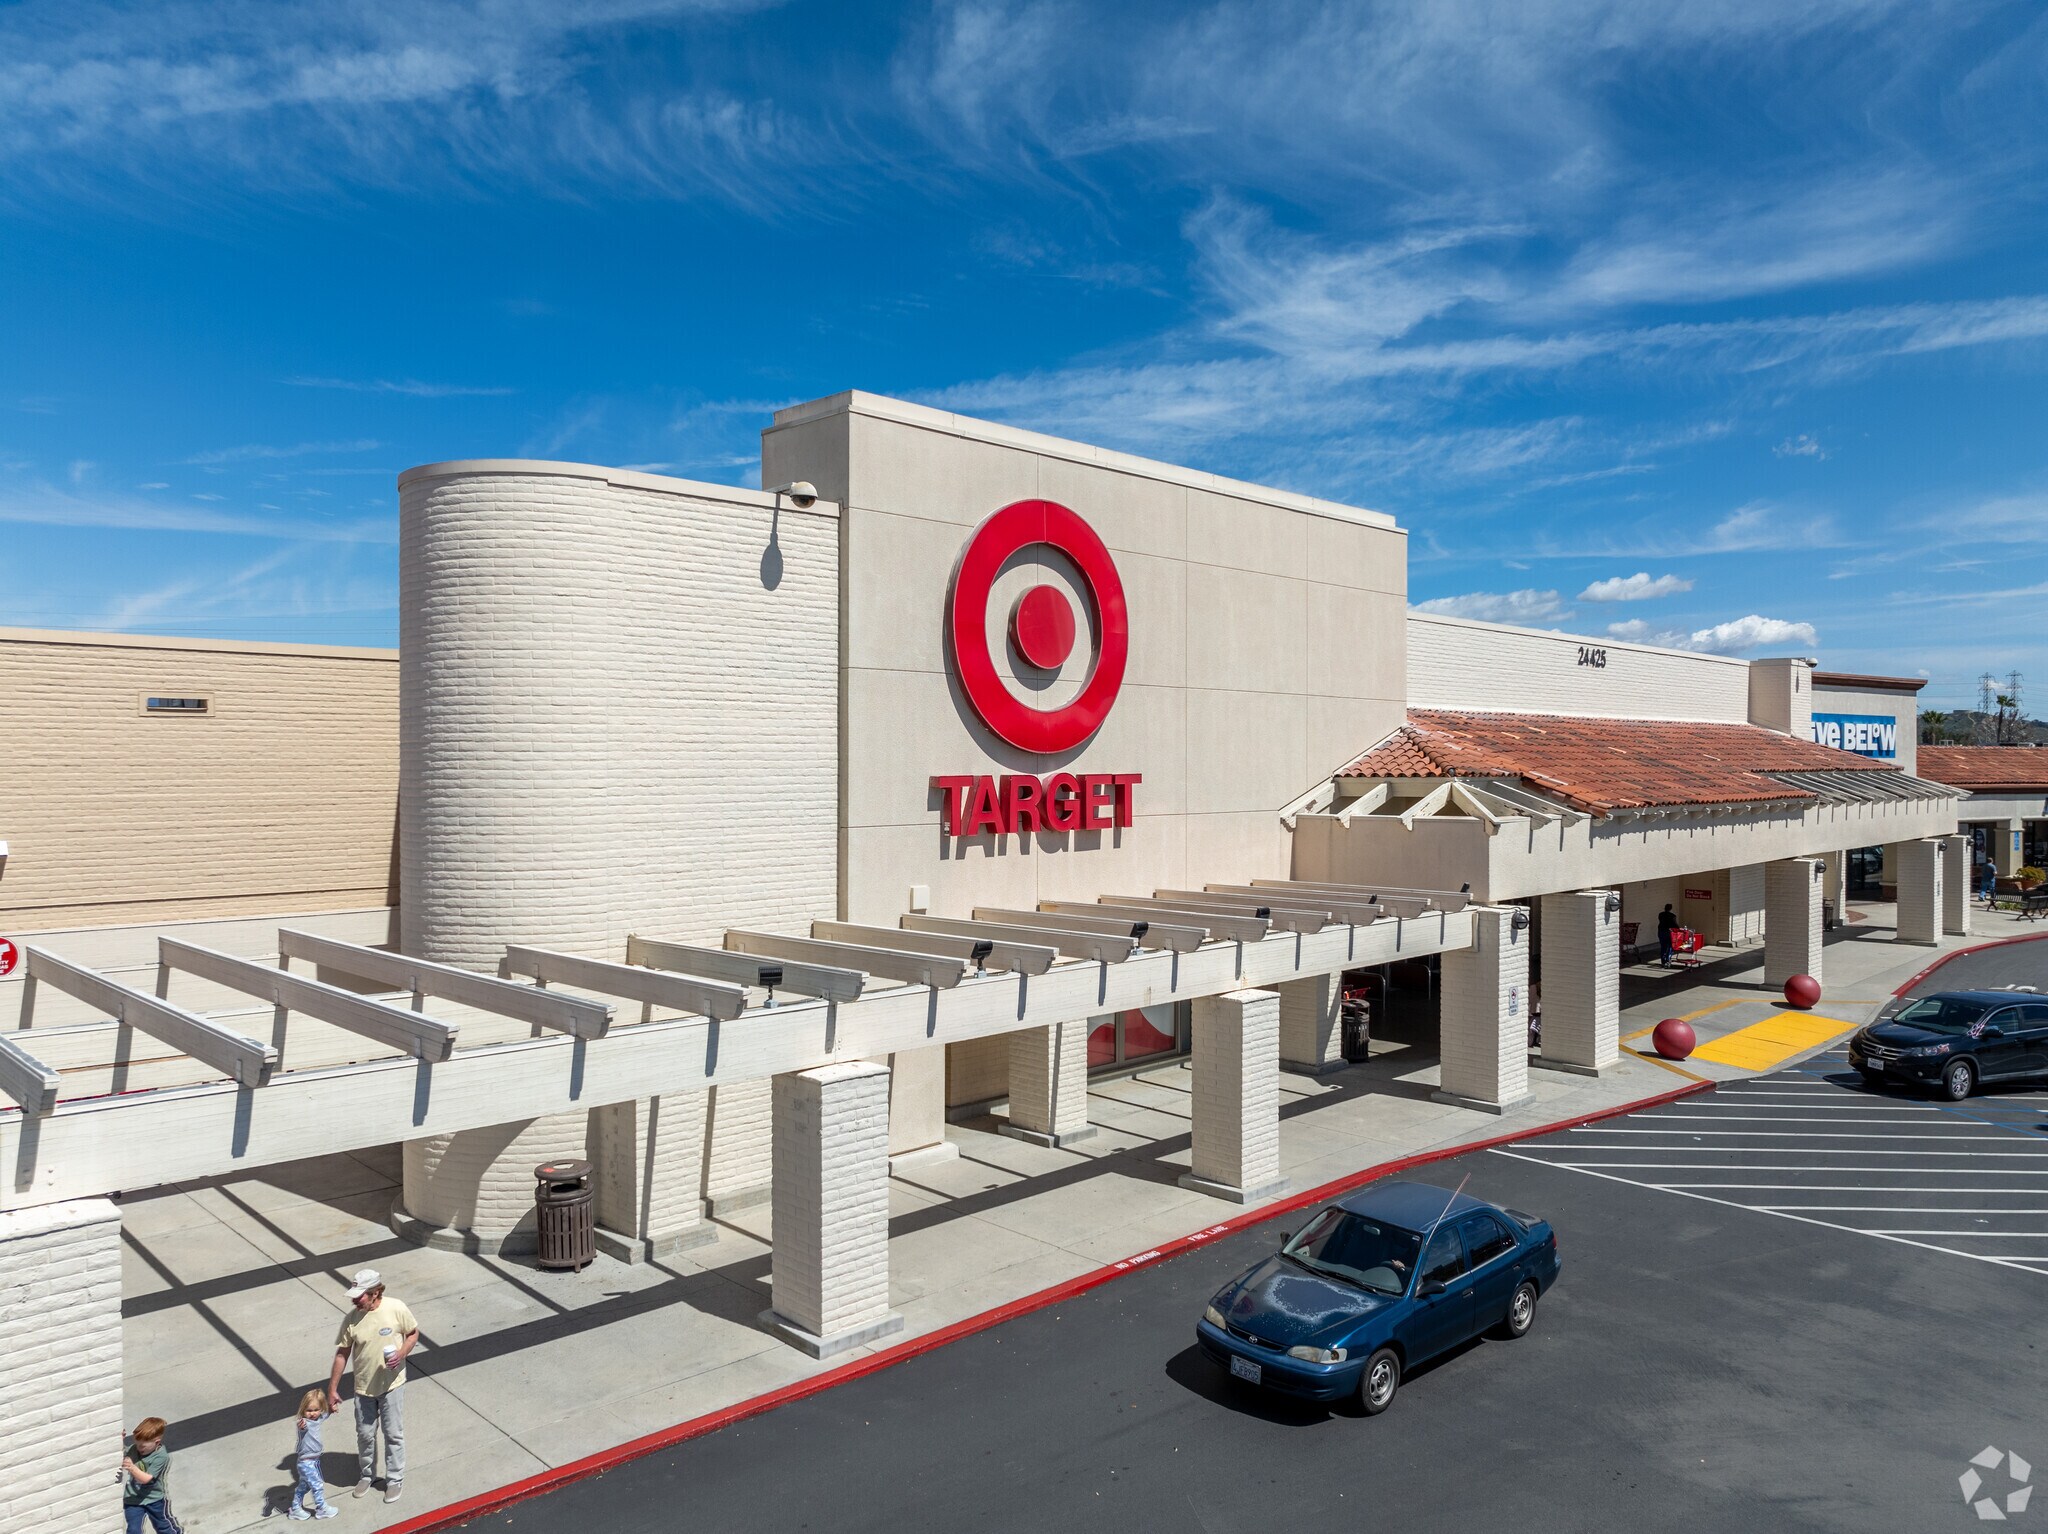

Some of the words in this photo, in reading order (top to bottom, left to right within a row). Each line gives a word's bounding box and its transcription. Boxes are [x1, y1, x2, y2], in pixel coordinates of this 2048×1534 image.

[1577, 646, 1606, 668] 24425
[1811, 721, 1840, 749] ive
[934, 772, 1142, 836] TARGET
[1187, 1232, 1208, 1242] FIRE
[1206, 1224, 1228, 1235] LANE
[1114, 1262, 1129, 1270] NO
[1128, 1250, 1161, 1265] PARKING
